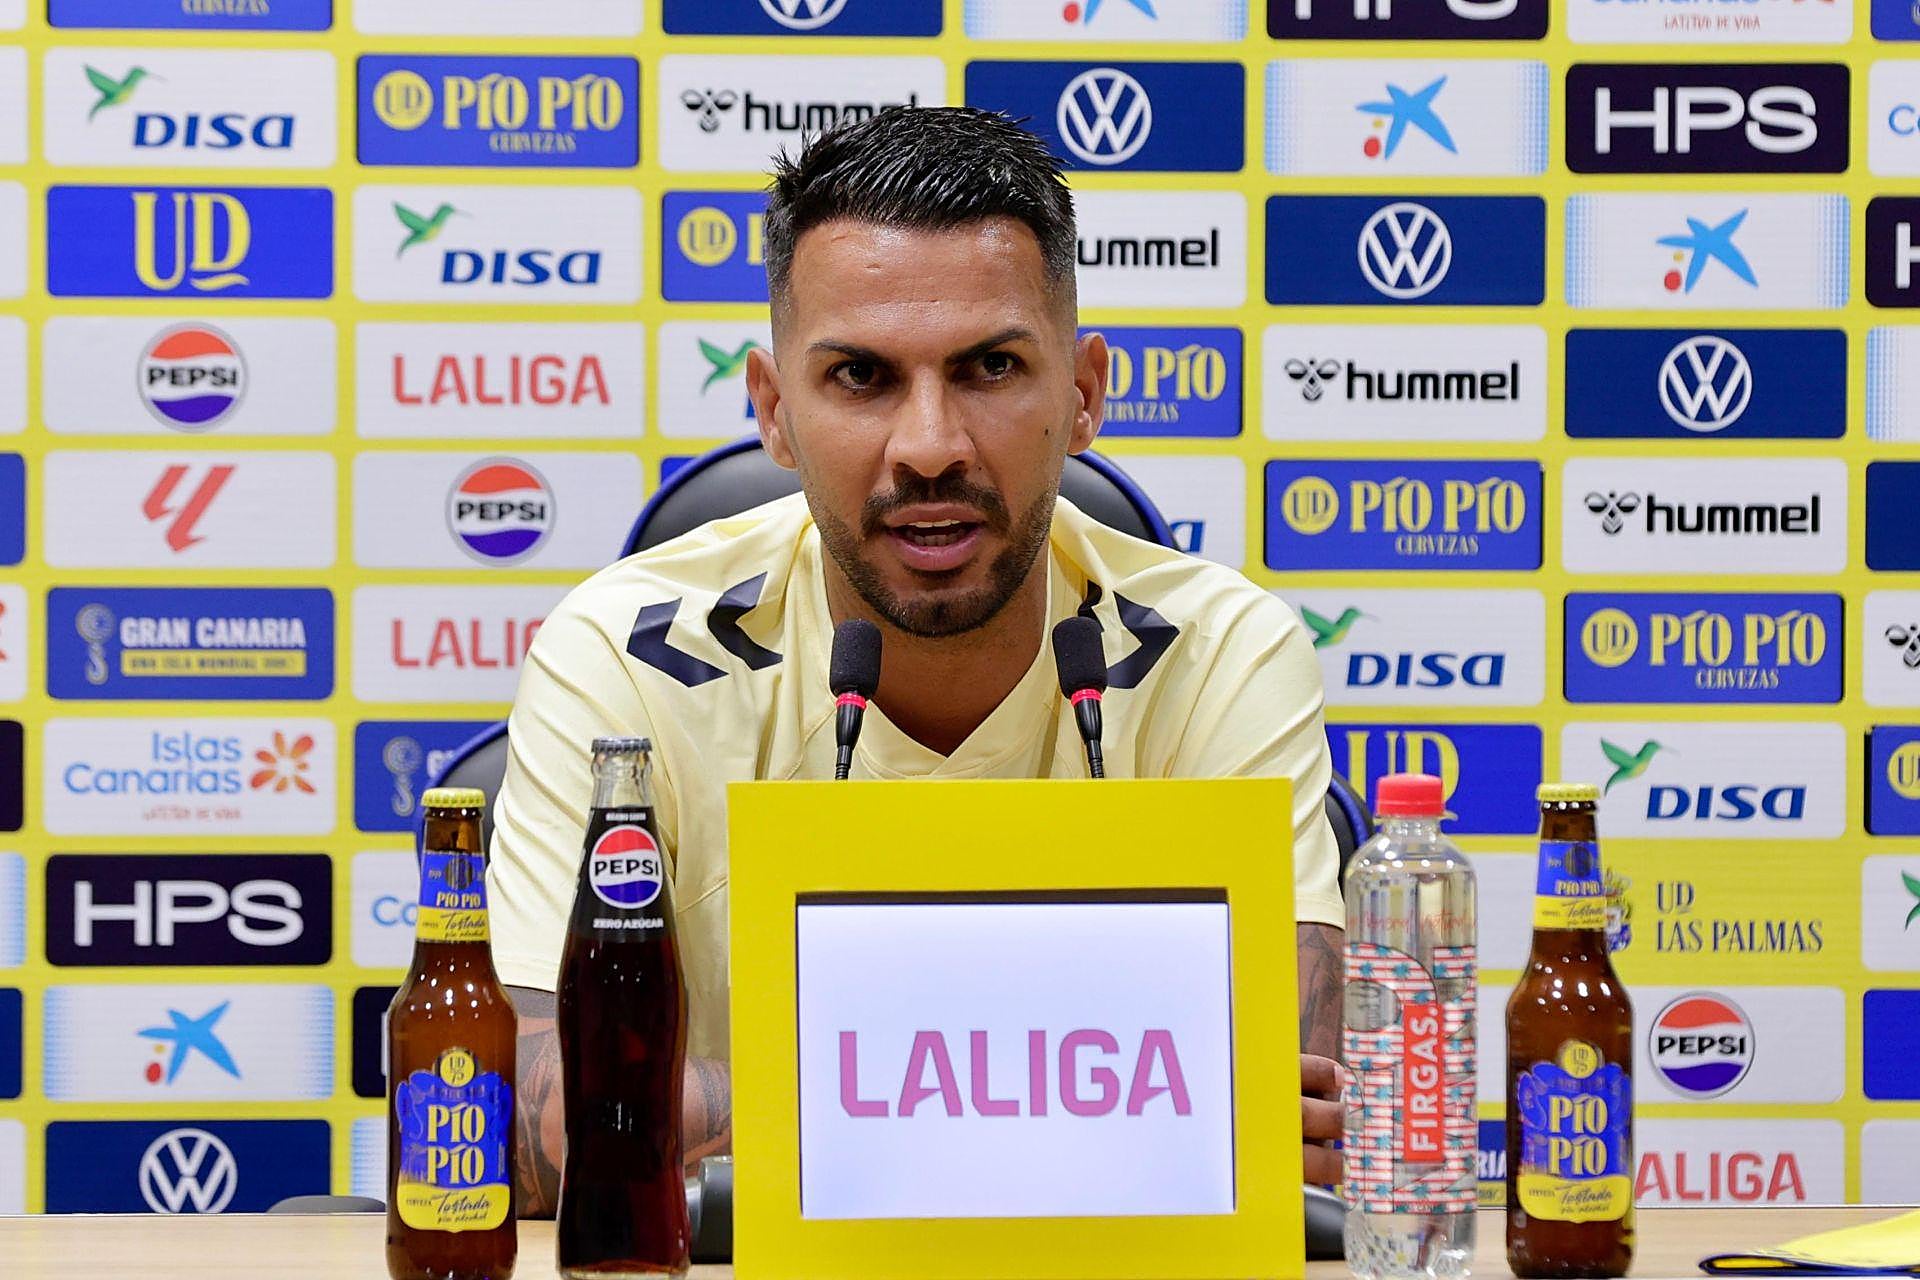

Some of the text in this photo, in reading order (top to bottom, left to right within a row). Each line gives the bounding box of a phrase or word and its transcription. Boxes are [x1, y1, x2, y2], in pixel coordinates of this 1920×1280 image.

[745, 93, 917, 131] humm
[1595, 86, 1818, 154] HPS
[133, 192, 250, 290] UD
[1077, 230, 1218, 266] ummel
[148, 366, 238, 387] PEPSI
[394, 355, 611, 406] LALIGA
[1347, 361, 1518, 400] hummel
[1103, 402, 1180, 423] ERVEZAS
[457, 502, 546, 522] PEPSI
[1647, 494, 1820, 533] hummel
[1395, 534, 1479, 556] CERVEZAS
[120, 617, 306, 648] GRAN CANARIA
[392, 618, 545, 669] LALI
[1696, 668, 1779, 690] CERVEZAS
[151, 731, 243, 763] Islas
[63, 763, 243, 795] Canarias
[594, 859, 659, 876] PEPSI
[74, 880, 304, 946] HPS
[1656, 881, 1695, 914] UD
[593, 917, 622, 929] ZERO
[1656, 919, 1823, 953] LAS PALMAS
[1658, 1035, 1746, 1056] PEPSI
[838, 1028, 1193, 1119] LALIGA
[427, 1102, 485, 1143] PÍO
[1551, 1093, 1608, 1134] PÍO
[427, 1143, 485, 1185] PÍO
[1550, 1134, 1608, 1176] PÍO
[1634, 1152, 1806, 1200] ALIGA
